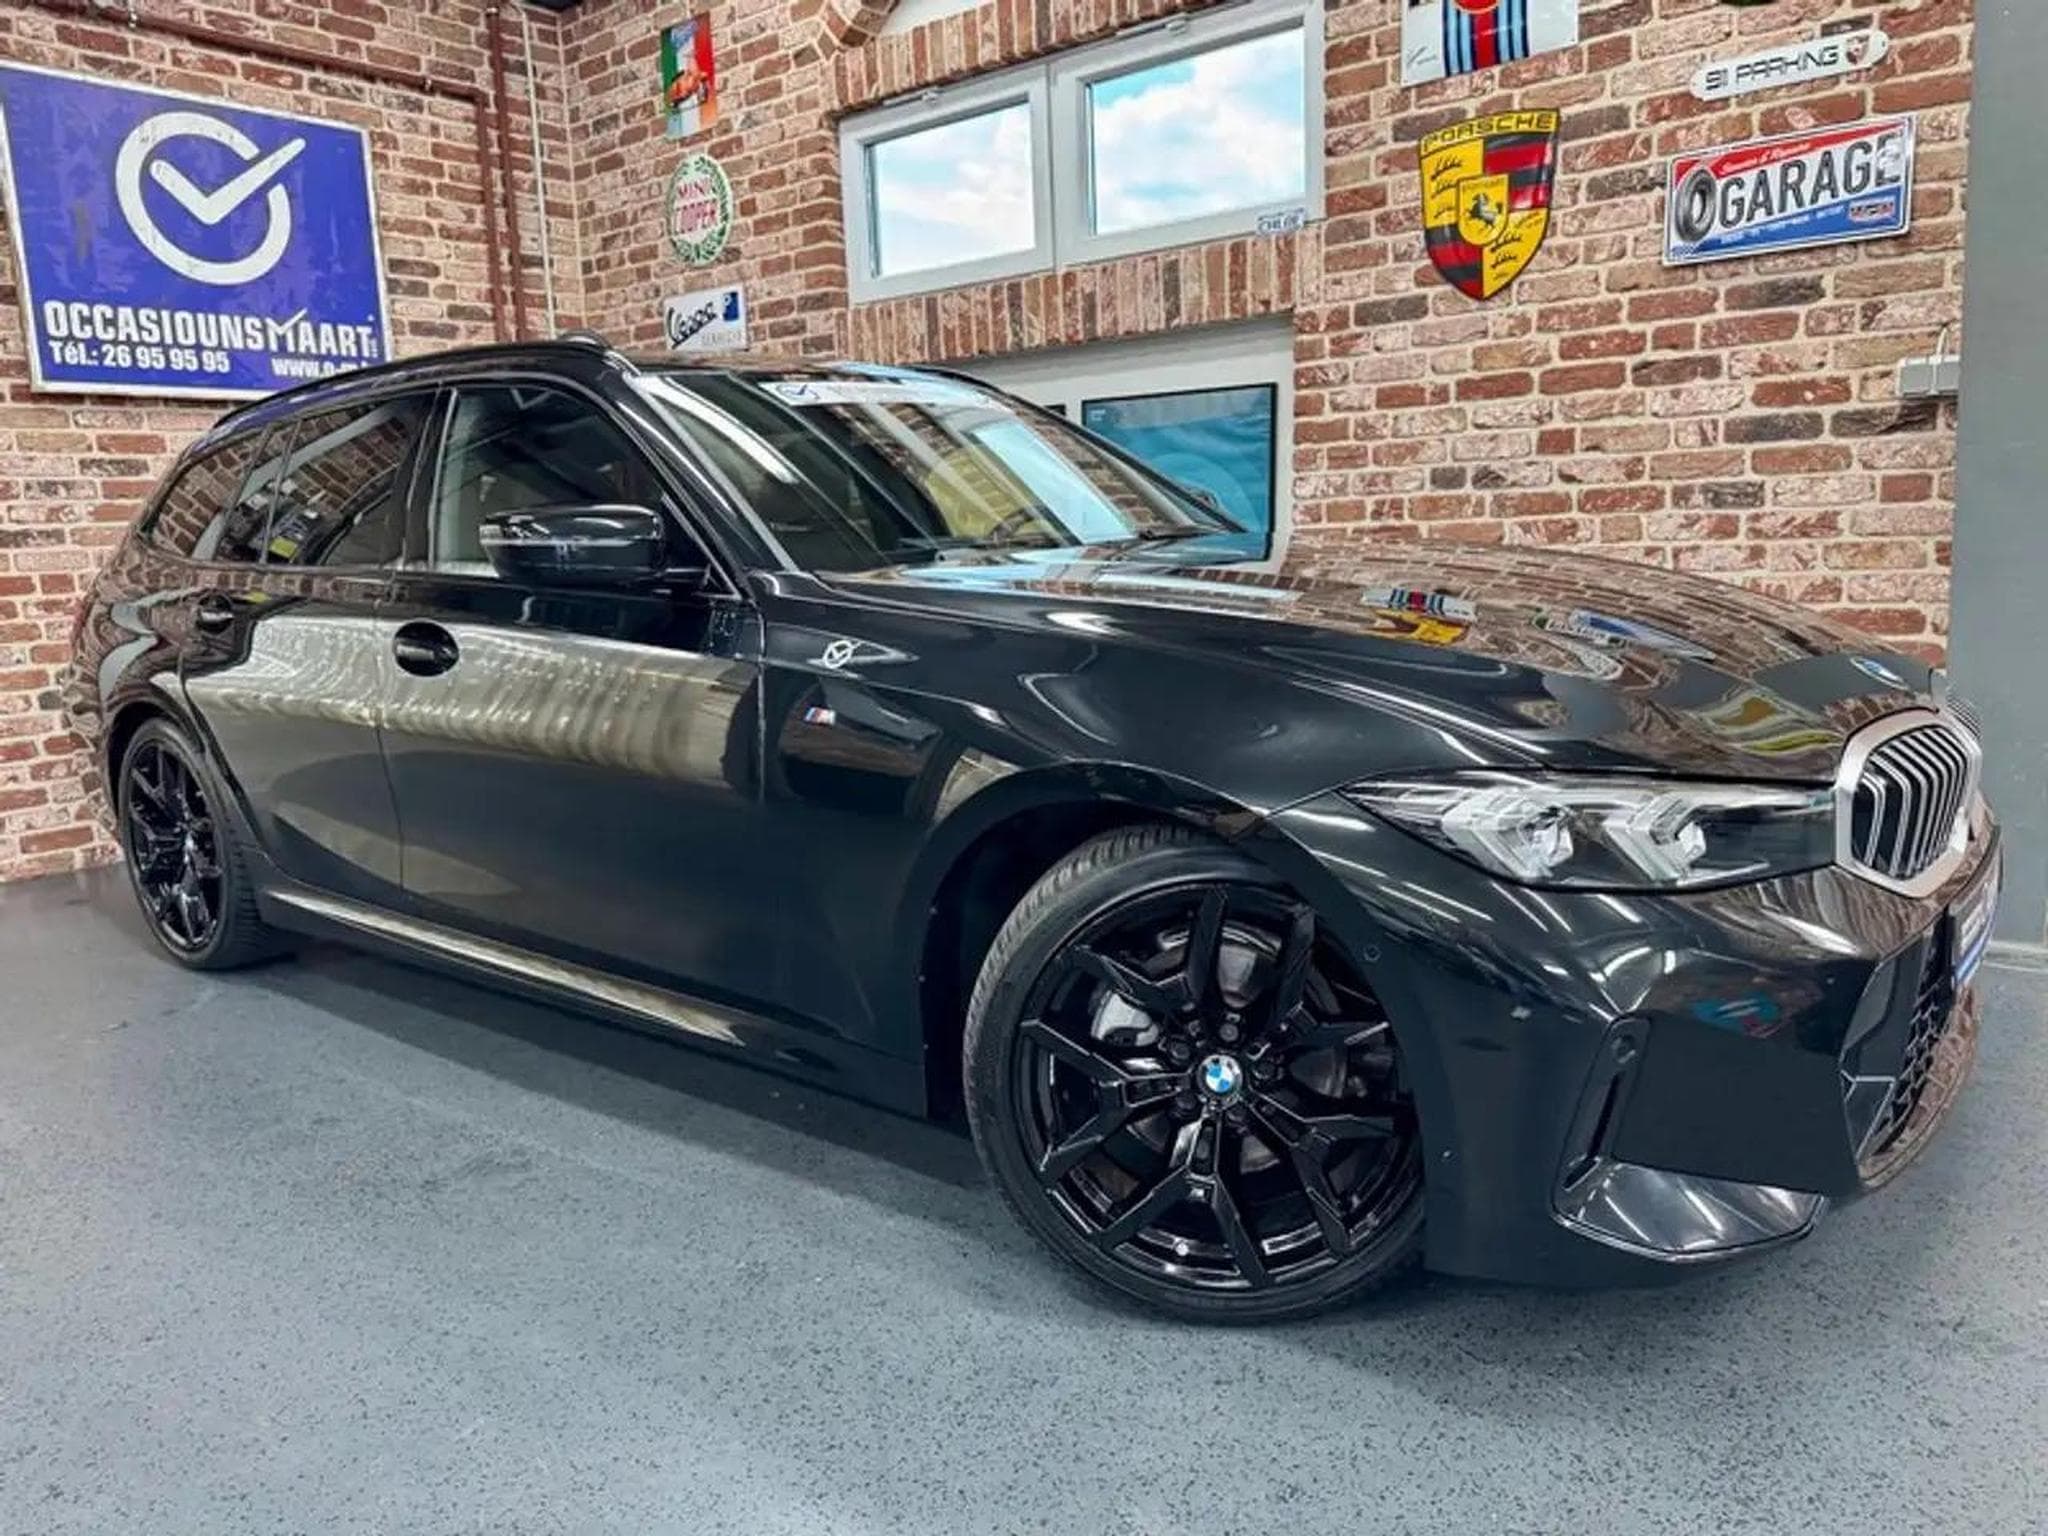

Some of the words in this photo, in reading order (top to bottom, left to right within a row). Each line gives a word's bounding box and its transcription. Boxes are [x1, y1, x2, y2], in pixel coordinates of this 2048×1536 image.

[1735, 45, 1839, 83] PARKING
[1423, 113, 1553, 152] PORSCHE
[1719, 132, 1903, 229] GARAGE
[43, 300, 373, 358] OCCASIOUNSMAART
[101, 344, 131, 368] 26
[135, 346, 166, 370] 95
[169, 348, 199, 372] 95
[201, 350, 231, 374] 95
